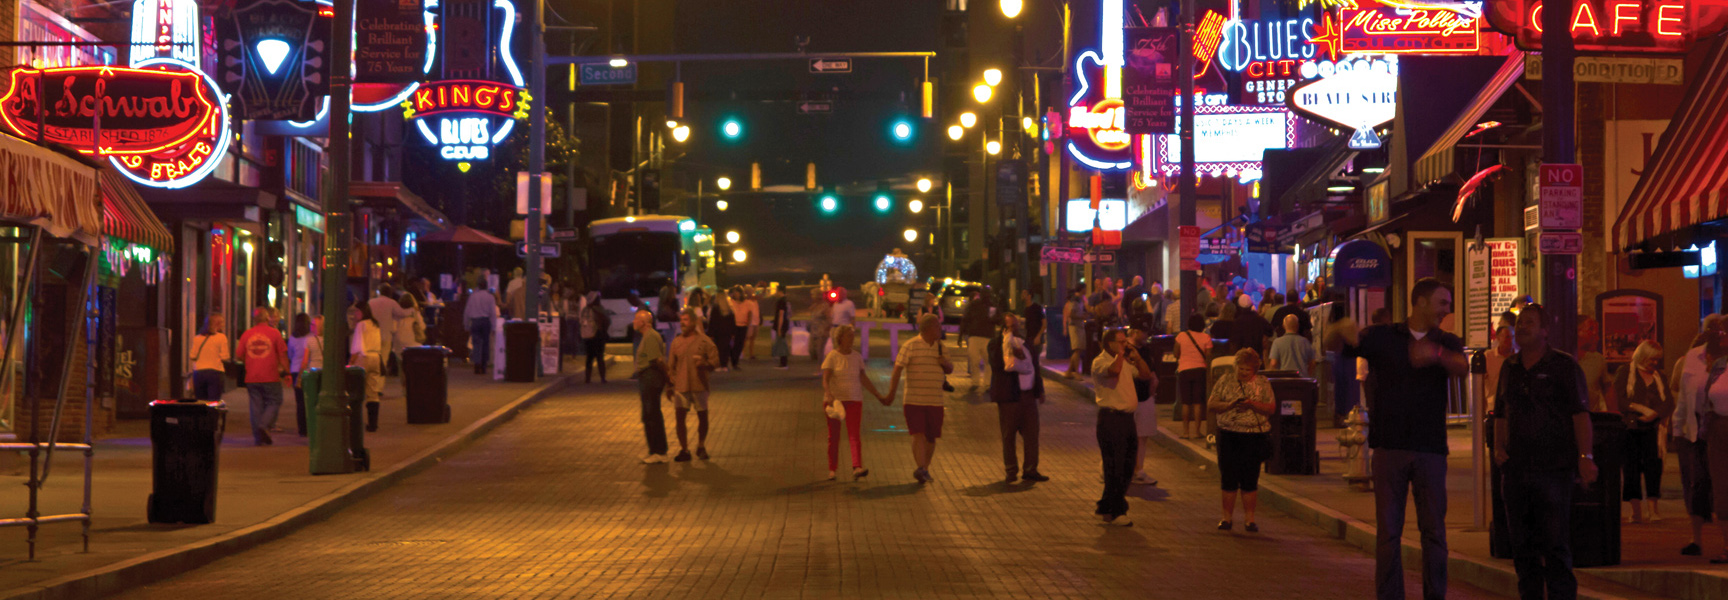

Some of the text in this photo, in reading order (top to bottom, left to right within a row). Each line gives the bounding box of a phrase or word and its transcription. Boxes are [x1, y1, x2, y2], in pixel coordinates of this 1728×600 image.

[360, 17, 420, 33] Celebrating
[1345, 10, 1402, 33] Miss
[368, 32, 413, 45] Brilliant
[1234, 18, 1315, 71] BLUES
[1345, 38, 1391, 49] SOUL
[1394, 38, 1429, 49] CITY
[361, 46, 420, 59] Service for
[368, 61, 414, 73] 75 Years
[585, 66, 632, 80] Second
[1248, 59, 1317, 78] CIT
[1576, 62, 1678, 78] ONDITIONED
[55, 75, 199, 118] Schwab
[1126, 84, 1173, 97] Celebrating
[1133, 96, 1167, 106] Brilliant
[1128, 106, 1172, 117] Service for
[1132, 118, 1167, 127] 75 Years
[1255, 117, 1275, 125] WEEK
[46, 127, 169, 143] ESTABLSHED 1876
[151, 141, 212, 179] BEALE
[1548, 168, 1574, 183] NO
[1543, 188, 1577, 198] PARKING
